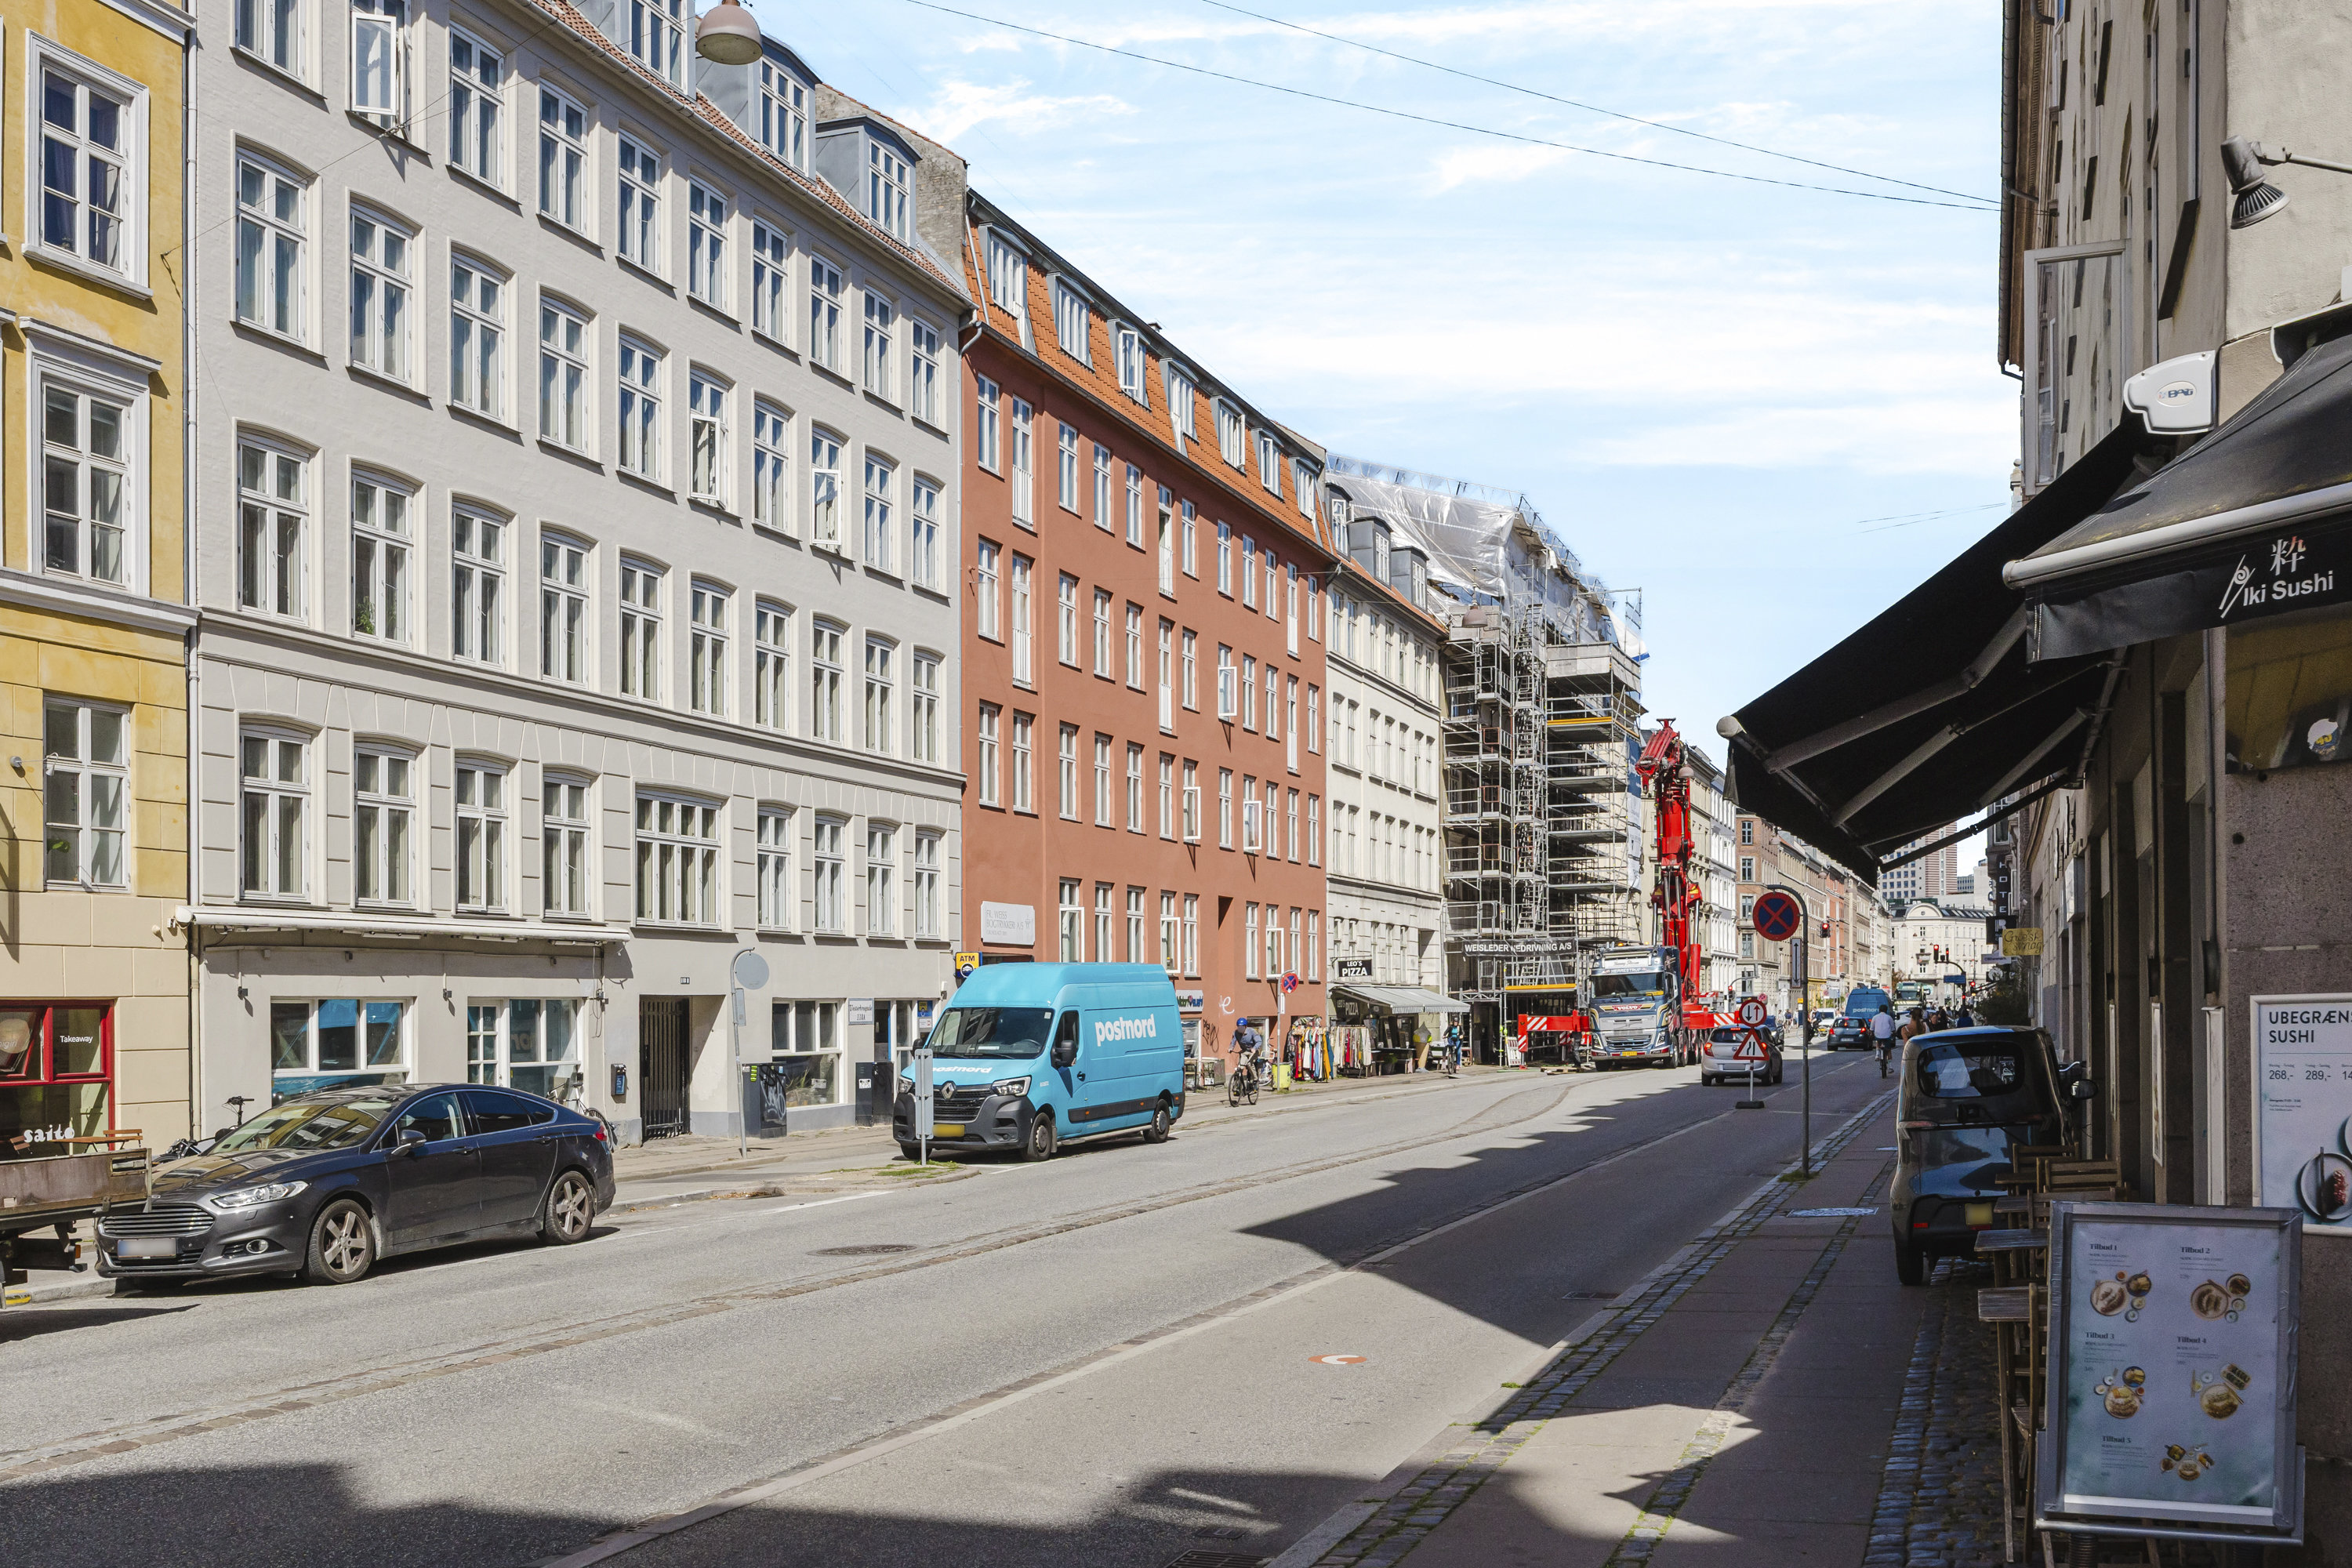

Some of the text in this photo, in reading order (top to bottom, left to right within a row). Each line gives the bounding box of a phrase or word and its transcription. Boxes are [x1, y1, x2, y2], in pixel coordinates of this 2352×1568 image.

[2243, 570, 2333, 606] Iki Sushi
[1465, 943, 1509, 953] WEISLEDER
[1559, 942, 1572, 950] A/S
[1341, 967, 1368, 977] PIZZA
[1345, 1002, 1359, 1016] PIZZA
[2269, 1010, 2352, 1025] UBEGRÆN
[1094, 1014, 1156, 1047] postnord
[2269, 1029, 2314, 1043] SUSHI
[60, 1035, 93, 1044] Takeaway
[2269, 1069, 2293, 1080] 268,-
[2305, 1070, 2331, 1081] 289,-
[24, 1124, 75, 1142] saito
